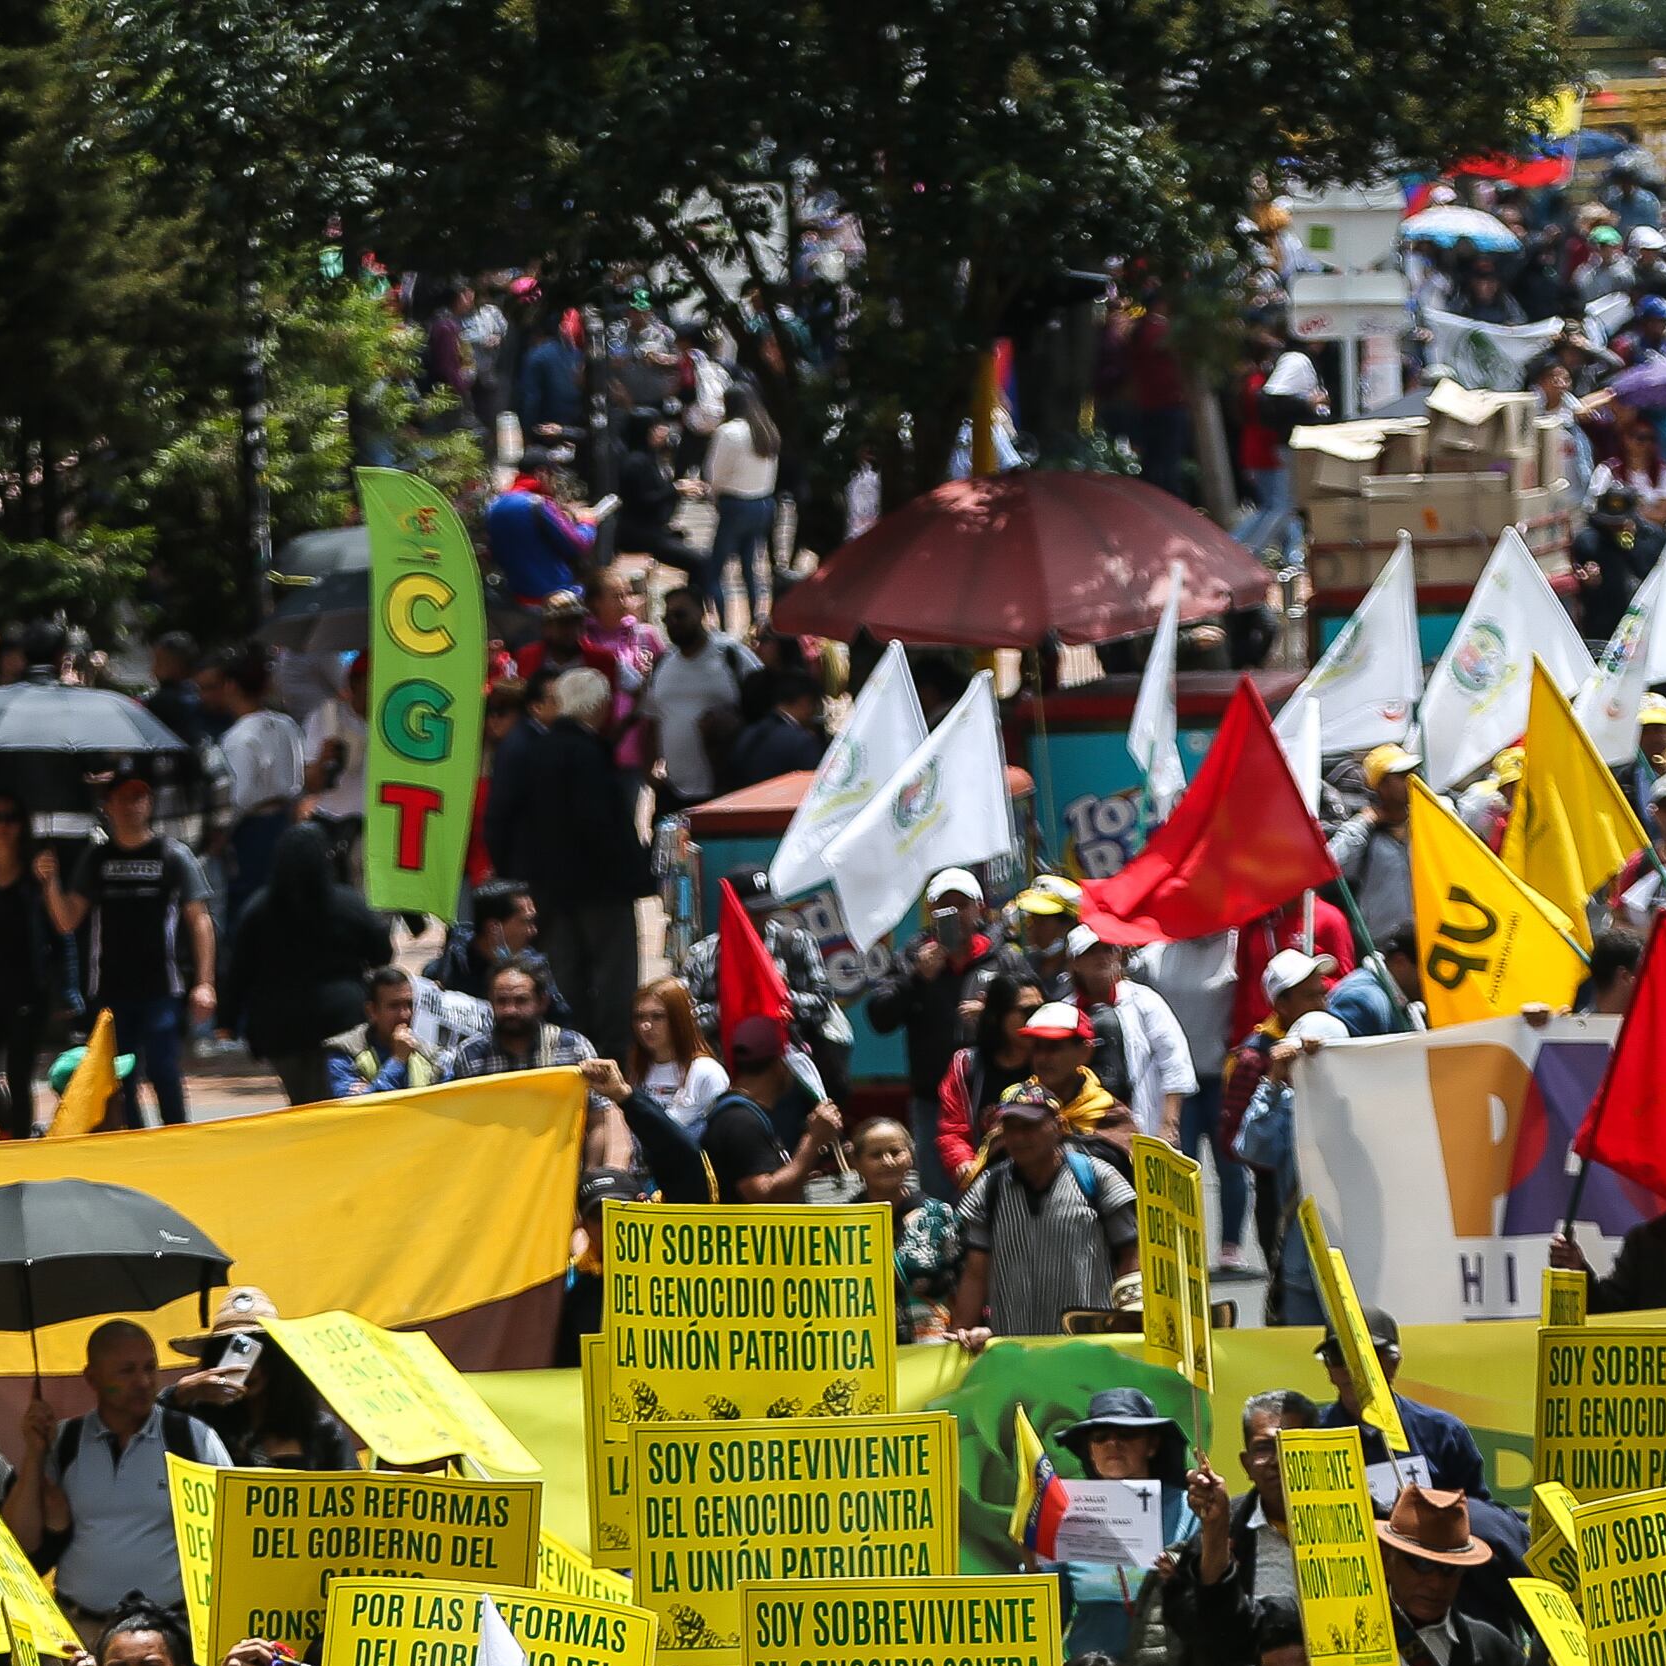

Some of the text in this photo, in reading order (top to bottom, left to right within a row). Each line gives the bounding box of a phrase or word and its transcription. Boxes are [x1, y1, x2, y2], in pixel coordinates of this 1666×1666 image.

[379, 572, 458, 872] CGT
[615, 1220, 872, 1266] SOY SOBREVIVIENTE
[614, 1273, 877, 1318] DEL GENOCIDIO CONTRA
[617, 1320, 875, 1371] LA UNIÓN PATRIÓTICA
[1582, 1523, 1609, 1572] SOY
[1586, 1583, 1611, 1630] DEL
